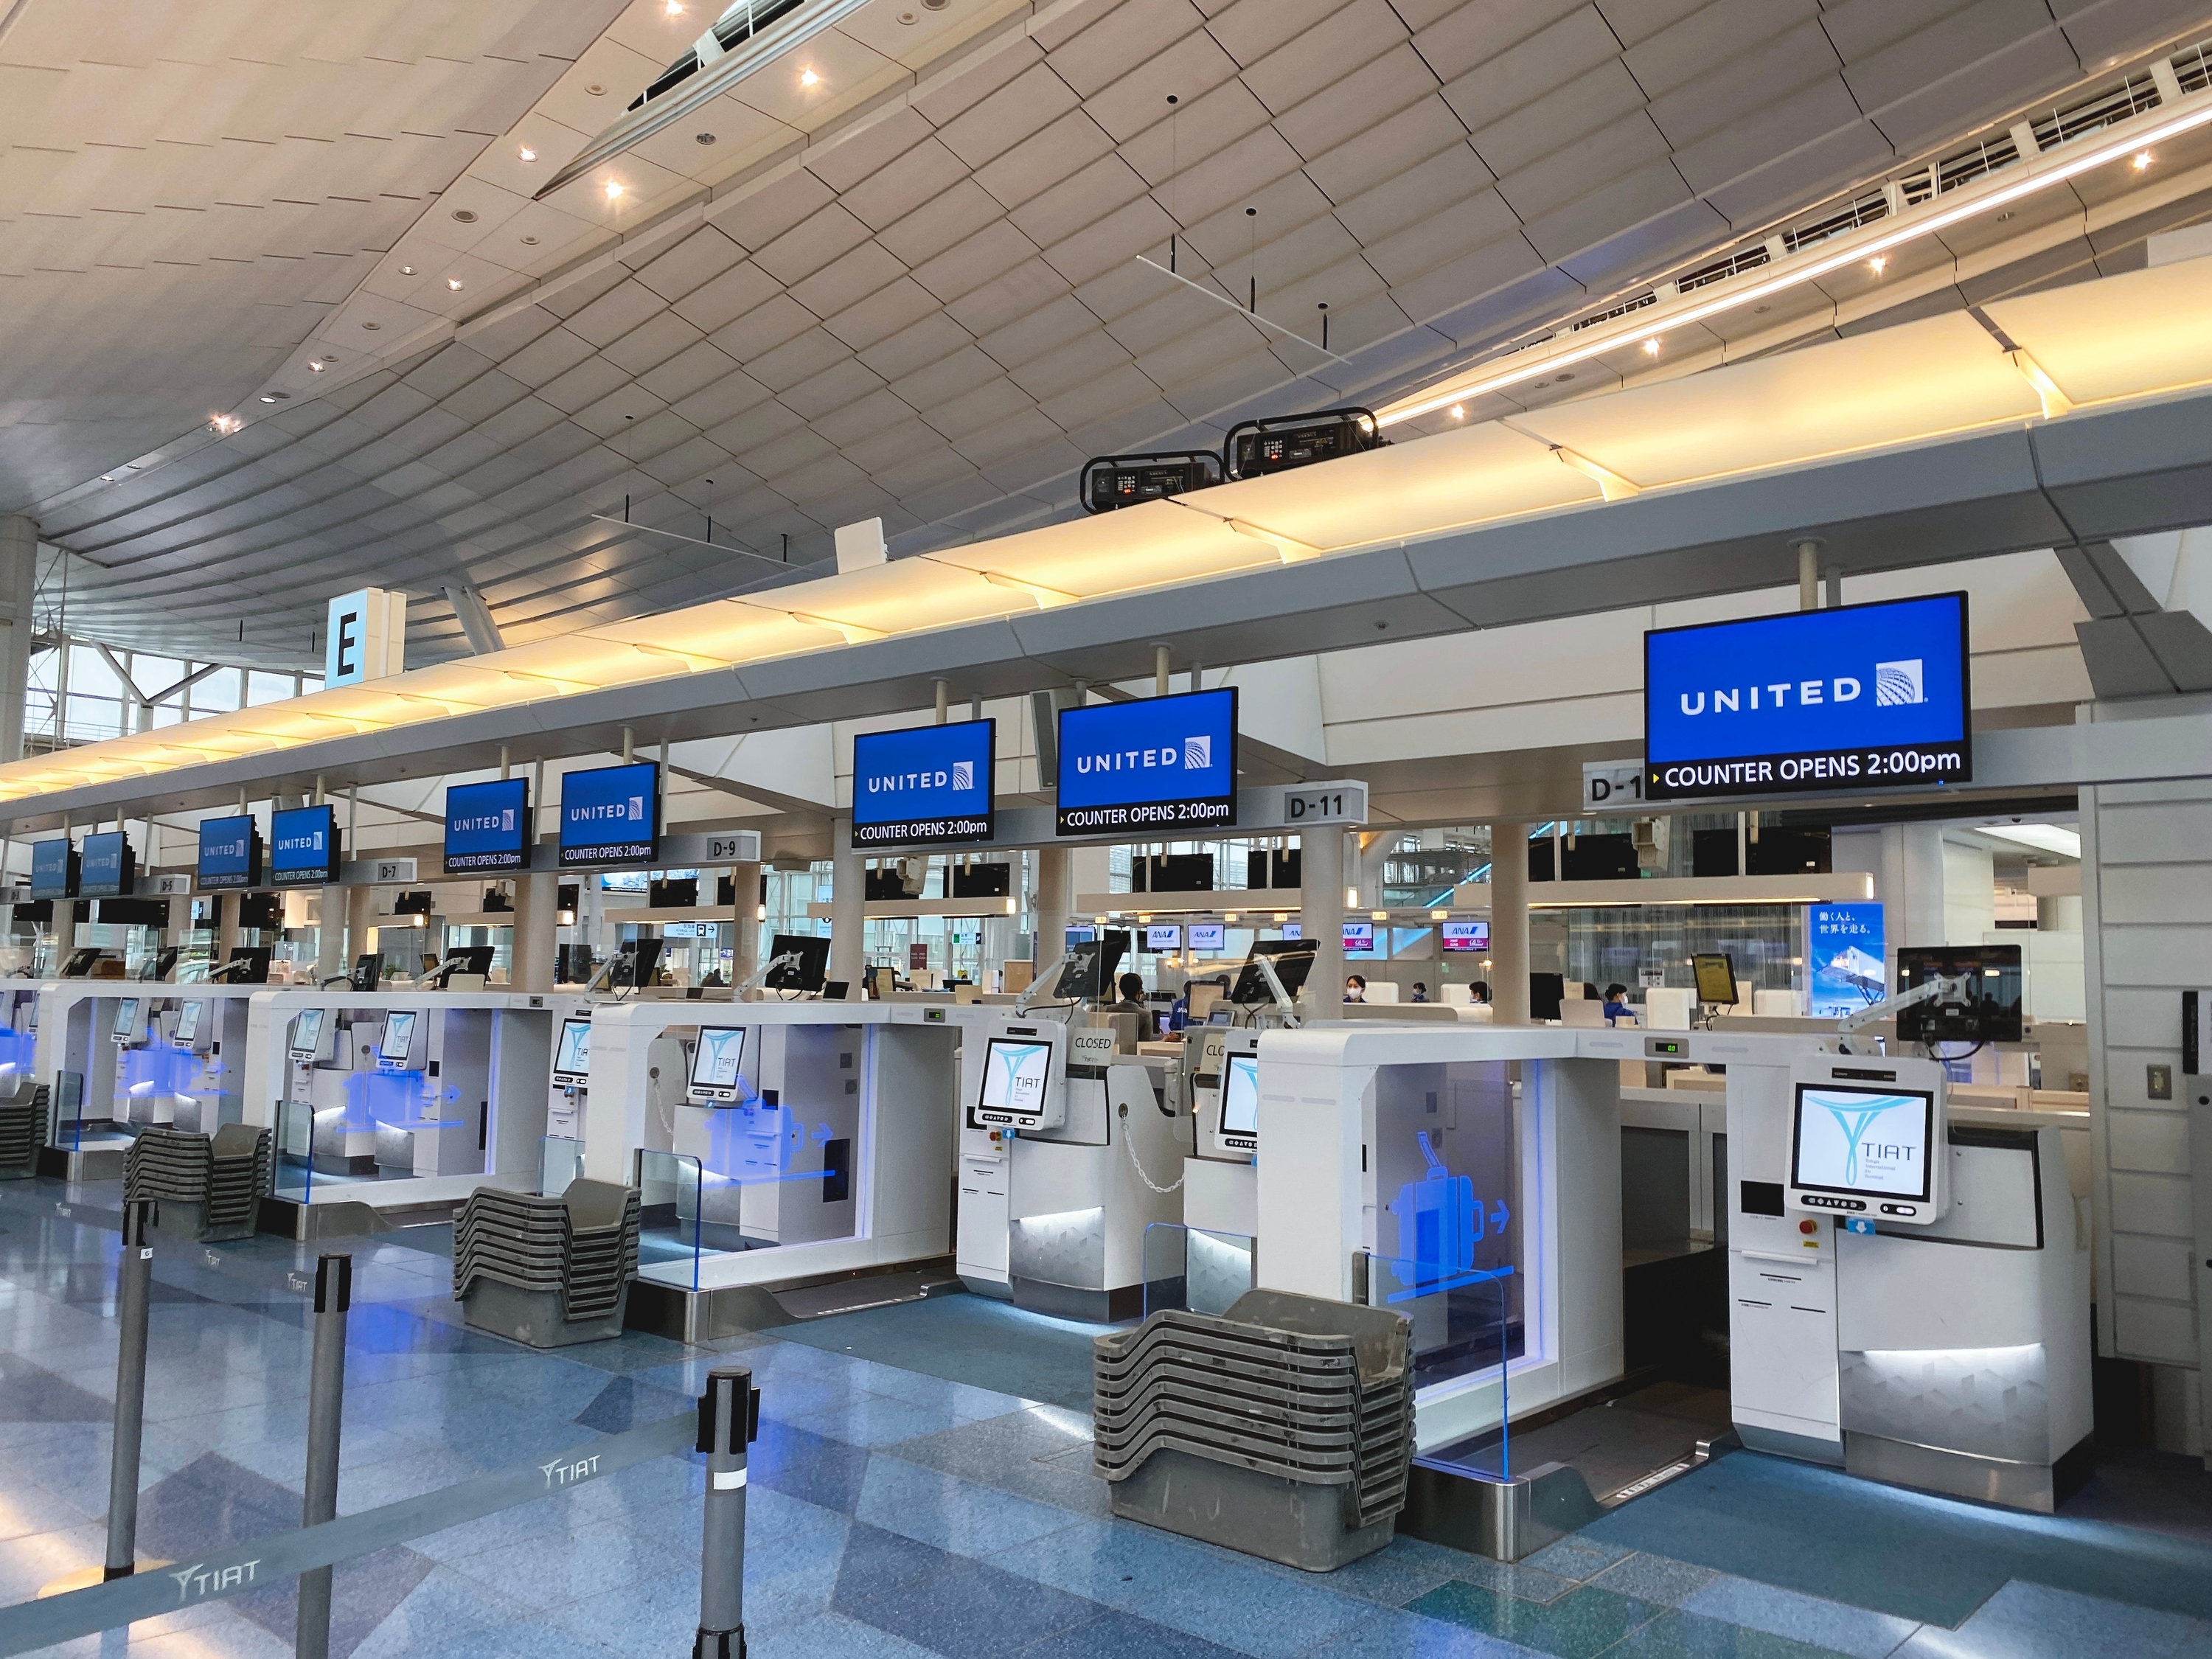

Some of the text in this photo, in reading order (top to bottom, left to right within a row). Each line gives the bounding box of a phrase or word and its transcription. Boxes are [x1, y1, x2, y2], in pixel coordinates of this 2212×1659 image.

[337, 611, 358, 677] E
[1680, 676, 1862, 716] UNITED
[1077, 748, 1178, 773] UNITED
[1664, 750, 1961, 788] COUNTER OPENS 2:00pm
[868, 771, 947, 793] UNITED
[1592, 775, 1641, 801] D-1
[571, 804, 625, 821] UNITED
[1066, 802, 1229, 827] COUNTER OPENS 2:00pm
[1290, 795, 1344, 819] D-11
[453, 815, 499, 832] UNITED
[860, 819, 987, 840] COUNTER OPENS 2:00pm
[204, 844, 234, 857] UNITED
[278, 836, 312, 851] UNITED
[713, 841, 736, 857] D-9
[448, 853, 521, 867] COUNTER OPENS 2:00pm
[565, 845, 652, 860] COUNTER OPENS 2:00pm
[274, 871, 296, 881] COUNTER
[296, 870, 311, 880] OPENS
[382, 866, 396, 878] D-7
[162, 880, 173, 891] D-5
[1819, 911, 1856, 922] 働く人と、
[1343, 928, 1355, 936] NA
[1451, 927, 1470, 935] ANA
[1818, 923, 1871, 935] 世界を走る。
[1074, 1037, 1112, 1049] CLOSED
[1206, 1044, 1225, 1057] CLO
[577, 1048, 588, 1056] TIA
[717, 1057, 737, 1067] TIAT
[1015, 1077, 1041, 1089] TIAT
[1861, 1142, 1918, 1161] TIAT
[554, 1454, 601, 1485] TIAT
[193, 1558, 262, 1596] TIAT
